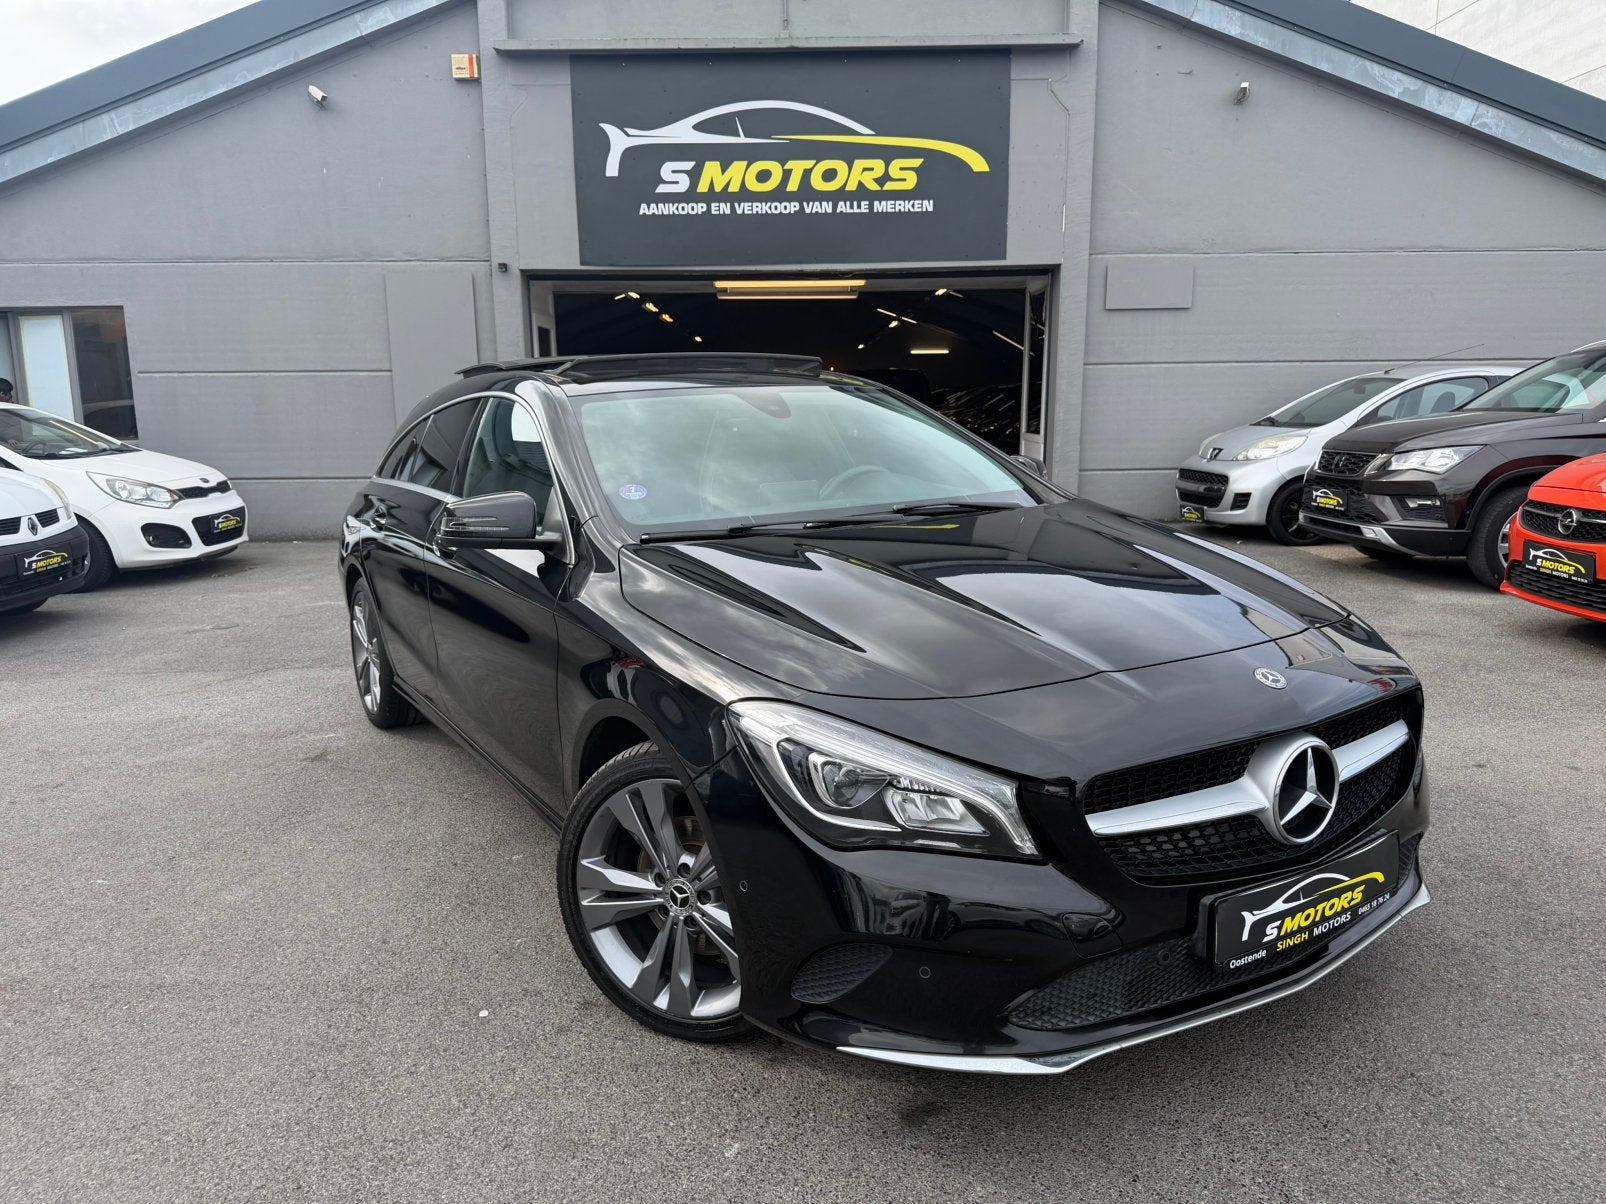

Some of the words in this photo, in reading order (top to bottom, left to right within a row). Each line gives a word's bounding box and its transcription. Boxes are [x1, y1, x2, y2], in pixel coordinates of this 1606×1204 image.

[655, 161, 696, 193] S
[697, 158, 924, 192] MOTORS
[639, 203, 708, 216] AANKOOP
[711, 202, 731, 215] EN
[735, 201, 800, 215] VERKOOP
[803, 201, 833, 214] VAN
[836, 200, 869, 213] ALLE
[873, 199, 934, 213] MERKEN
[36, 556, 62, 568] MOTORS
[1542, 559, 1576, 574] MOTORS
[1262, 919, 1282, 943] S
[1279, 884, 1366, 936] MOTORS
[1229, 948, 1267, 969] Oostende
[1276, 930, 1309, 952] SINGH
[1313, 911, 1352, 937] MOTORS
